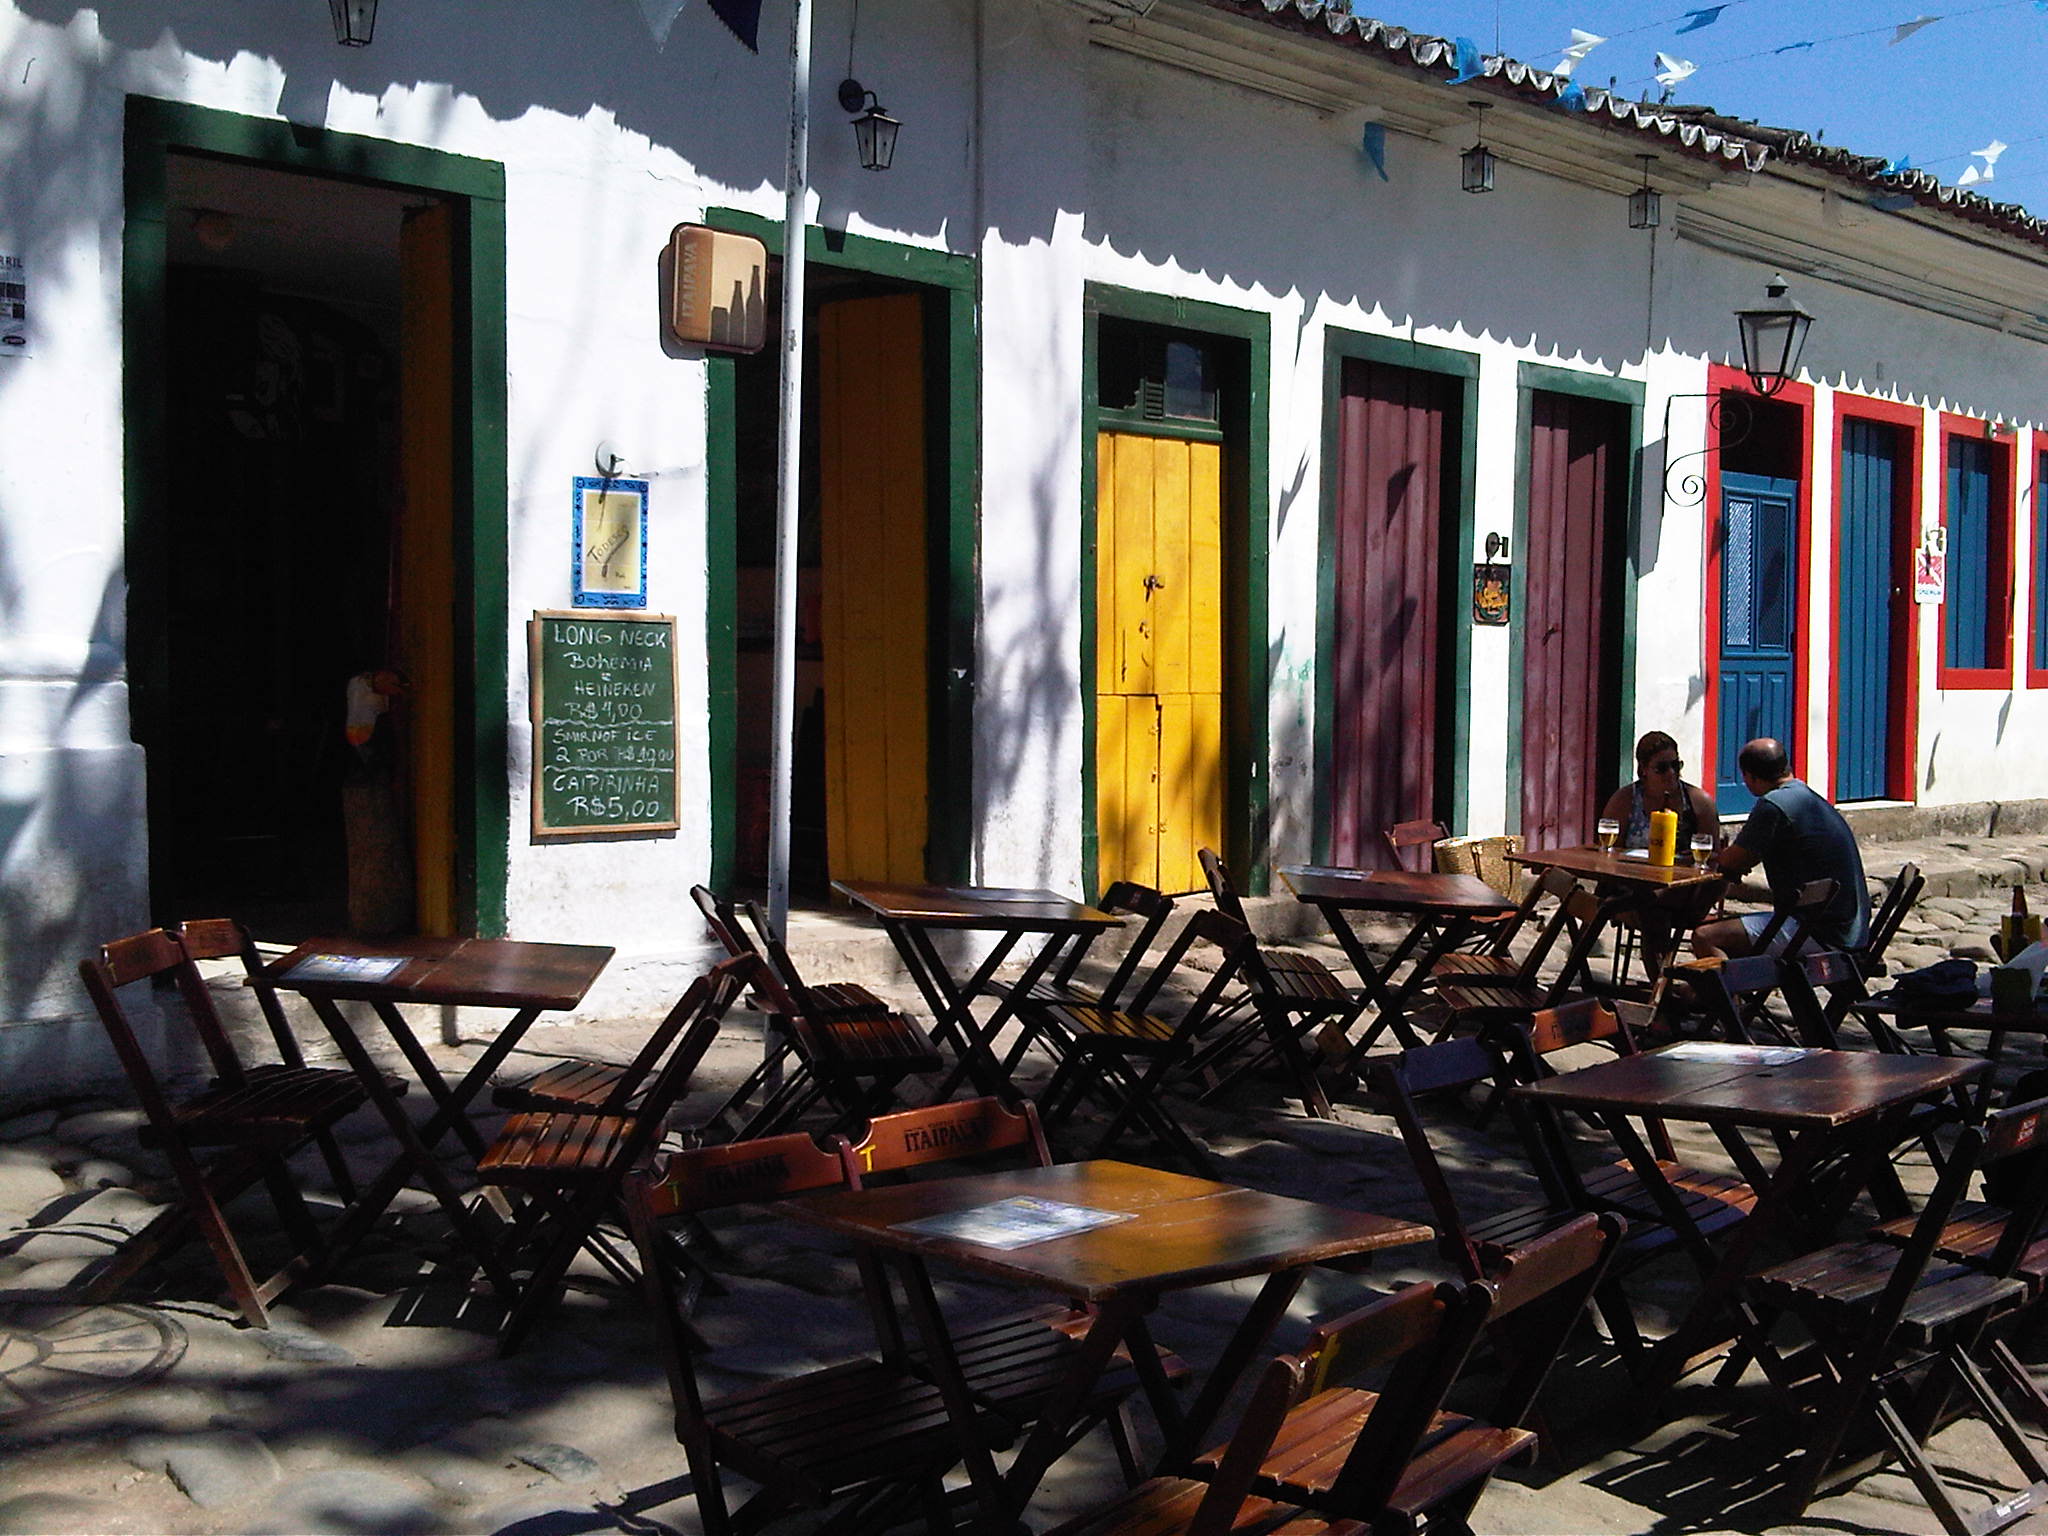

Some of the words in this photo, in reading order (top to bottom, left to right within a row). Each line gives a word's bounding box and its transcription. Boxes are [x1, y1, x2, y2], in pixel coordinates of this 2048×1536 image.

[682, 242, 698, 318] ITAIPAVA
[554, 623, 612, 646] LONG
[619, 629, 666, 649] NECK
[574, 680, 656, 698] HEINEKEN
[552, 728, 618, 744] SMIRNOF
[555, 745, 571, 763] 2
[577, 747, 609, 762] POR
[552, 774, 659, 794] CAIPIRINHA
[566, 795, 659, 821] R$5,00
[859, 1145, 876, 1172] T
